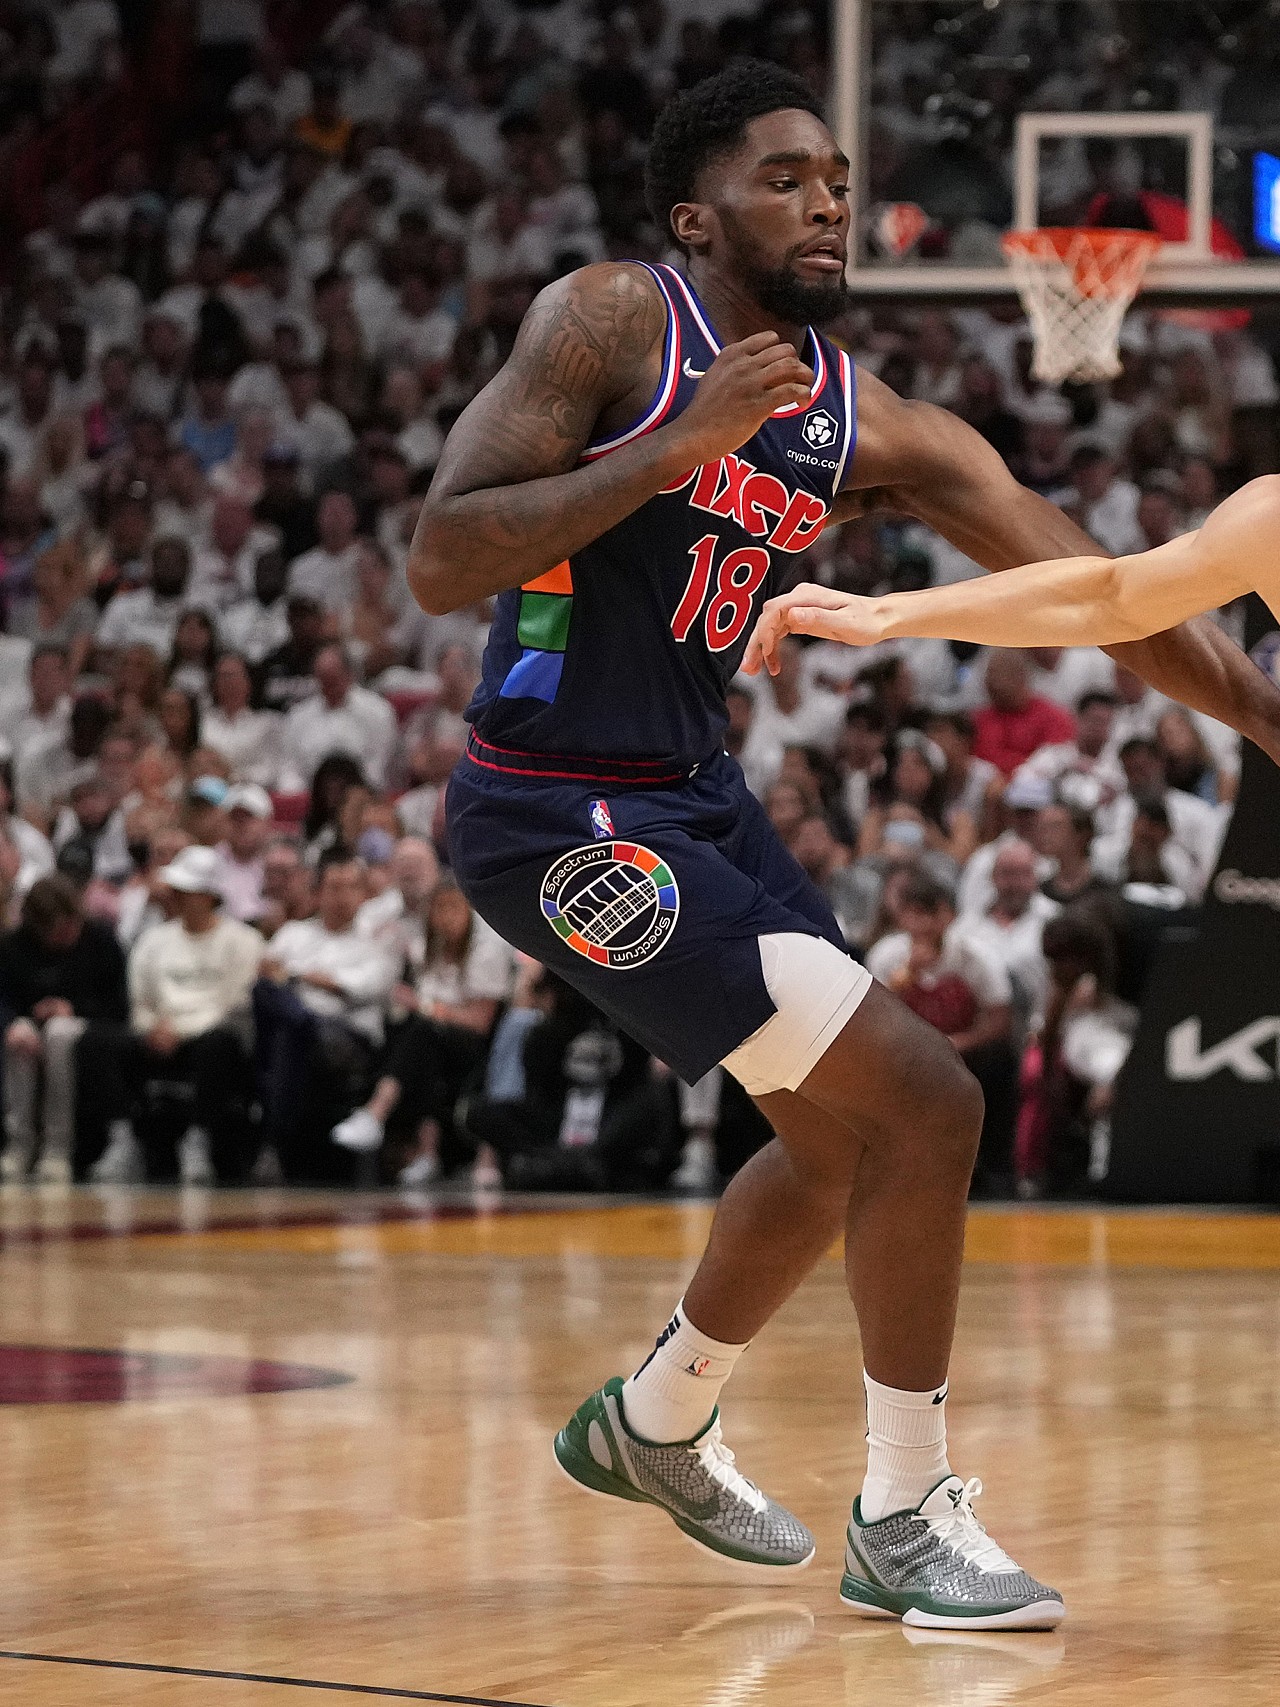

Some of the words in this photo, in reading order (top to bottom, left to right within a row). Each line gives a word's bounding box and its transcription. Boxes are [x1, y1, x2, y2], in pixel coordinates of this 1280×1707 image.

[670, 533, 770, 653] 18
[545, 848, 607, 895] Spectrum
[612, 916, 671, 962] Spectrum
